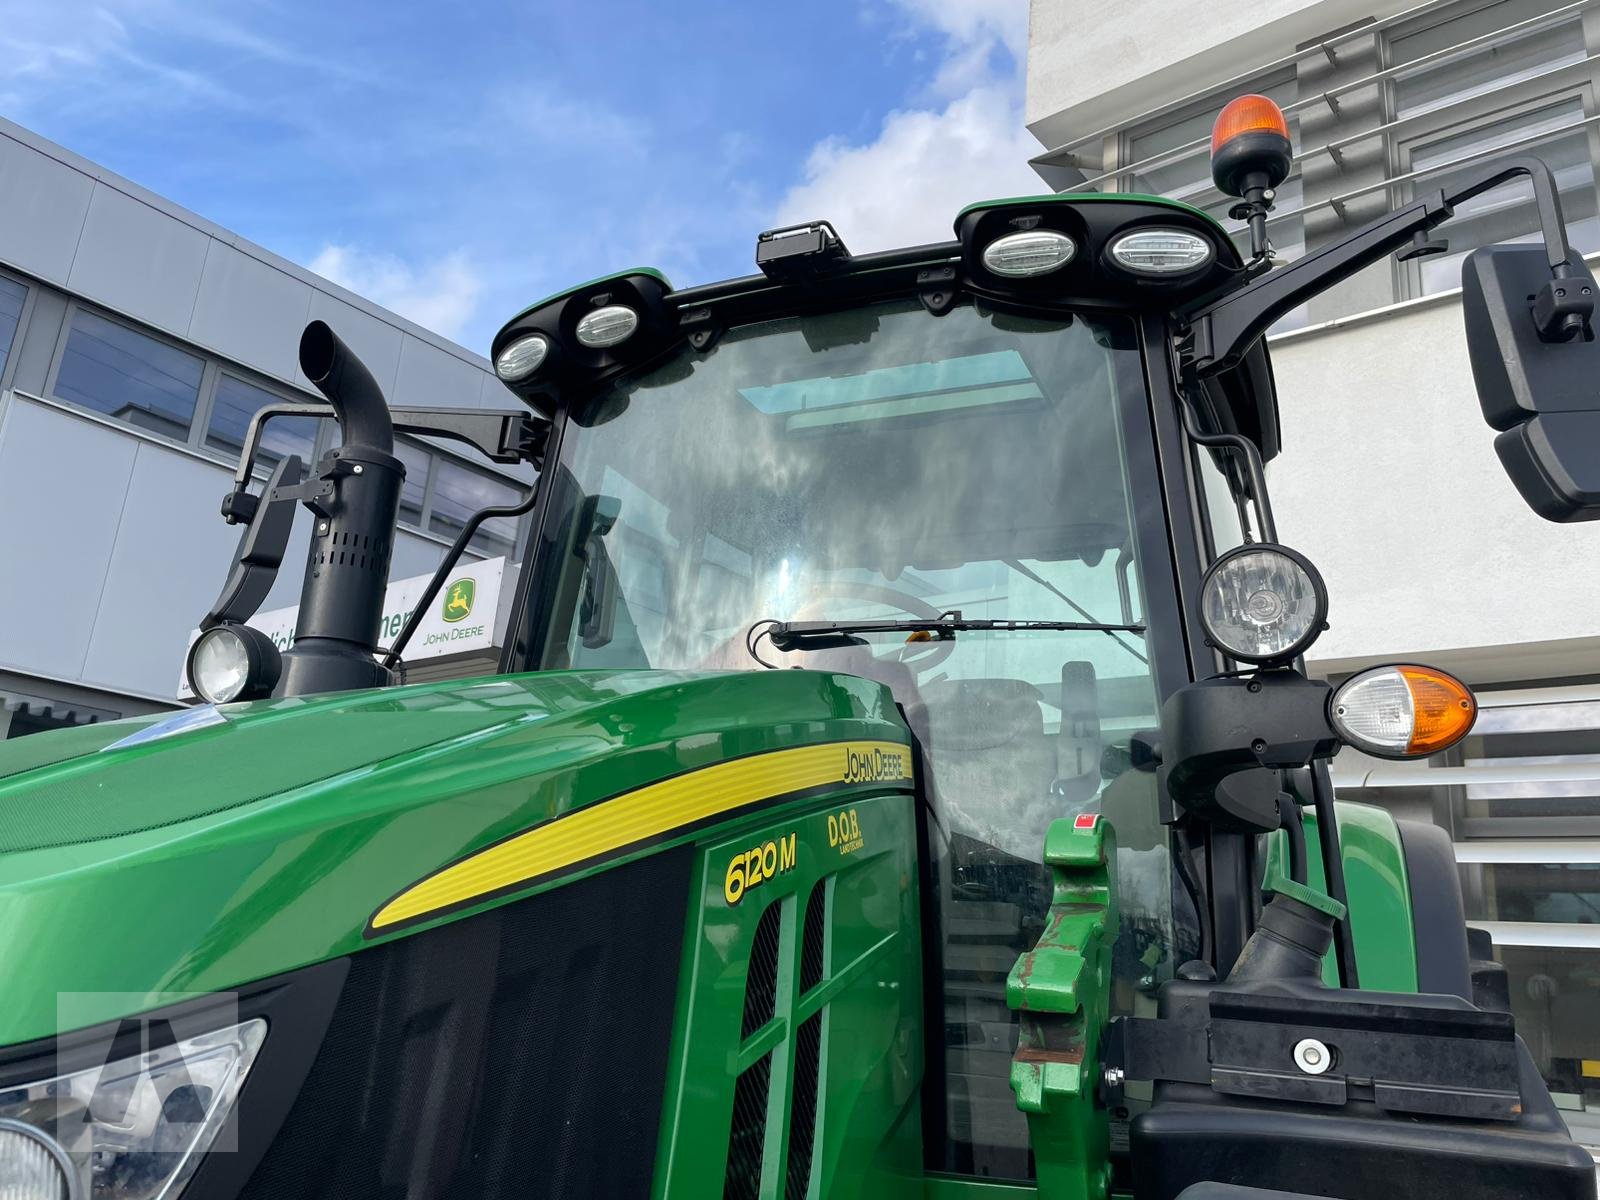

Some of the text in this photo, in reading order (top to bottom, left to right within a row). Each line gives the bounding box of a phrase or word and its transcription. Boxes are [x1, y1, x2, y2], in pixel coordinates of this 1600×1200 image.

[423, 625, 485, 646] JOHN DEERE
[843, 747, 903, 780] JOHN DEERE
[827, 808, 862, 848] D.O.B.
[724, 831, 797, 904] 6120 M
